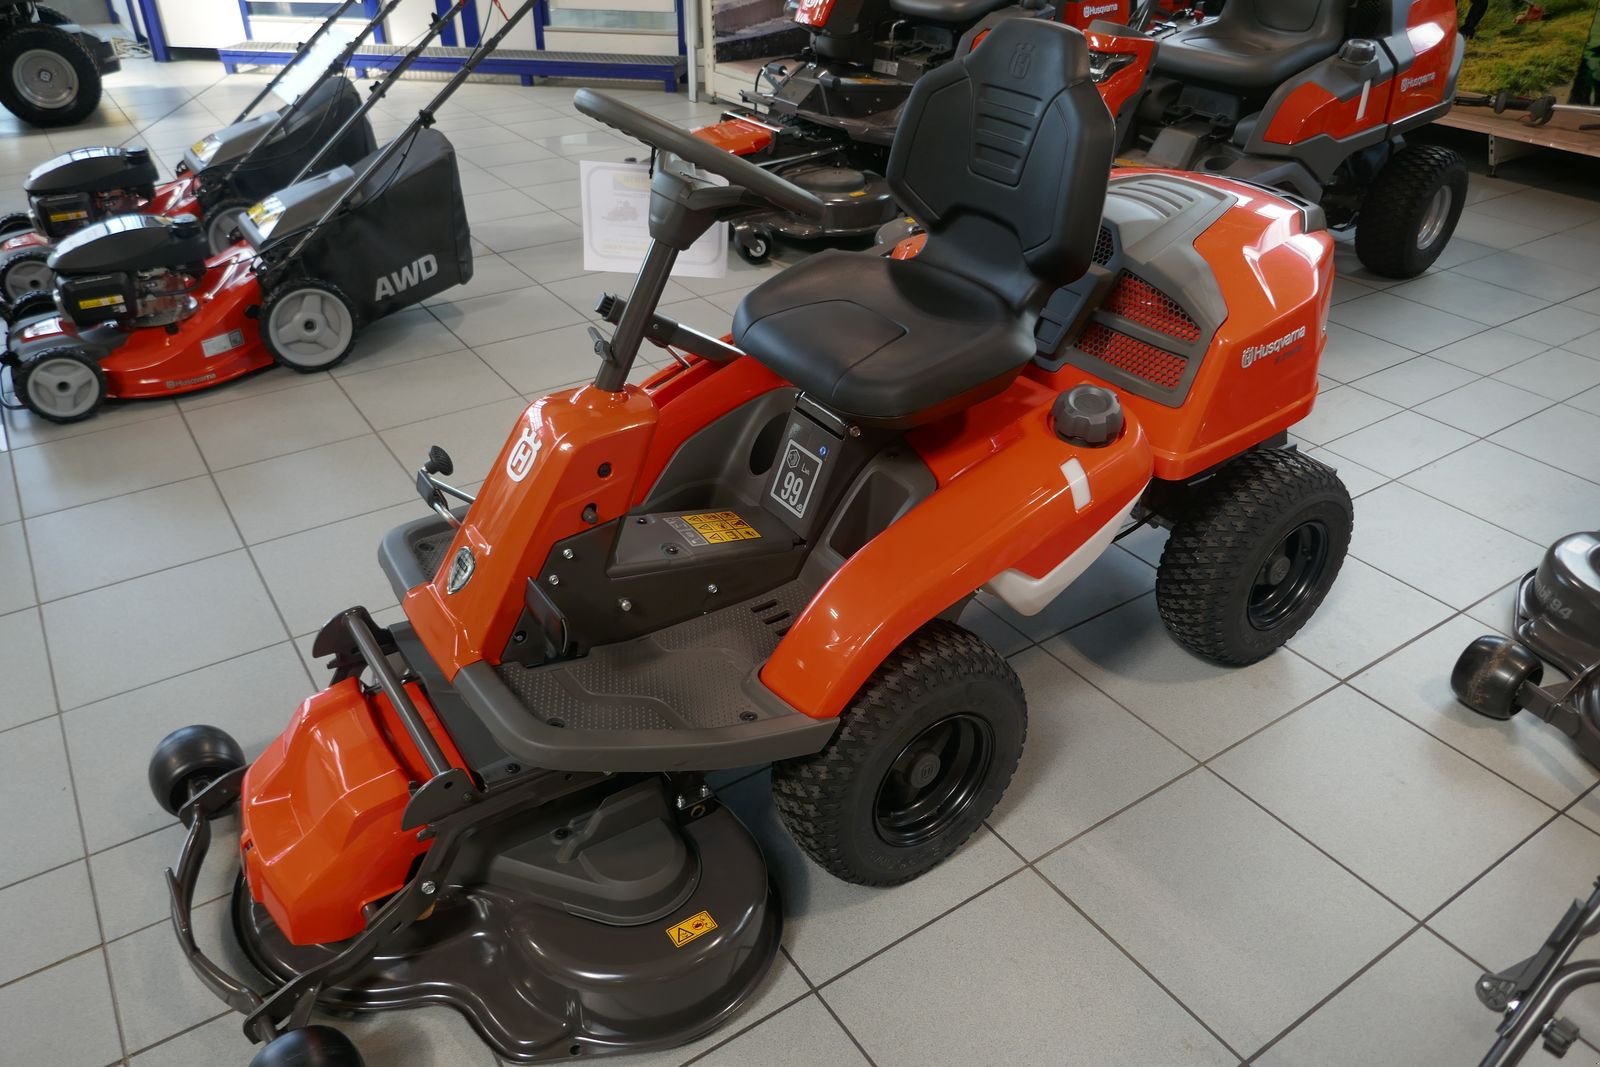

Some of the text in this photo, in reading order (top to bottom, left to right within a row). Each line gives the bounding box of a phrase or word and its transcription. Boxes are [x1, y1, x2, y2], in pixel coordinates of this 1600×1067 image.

[375, 253, 439, 302] AWD
[1253, 325, 1306, 361] Husqvarna
[781, 471, 804, 507] 99
[1550, 598, 1573, 620] 94
